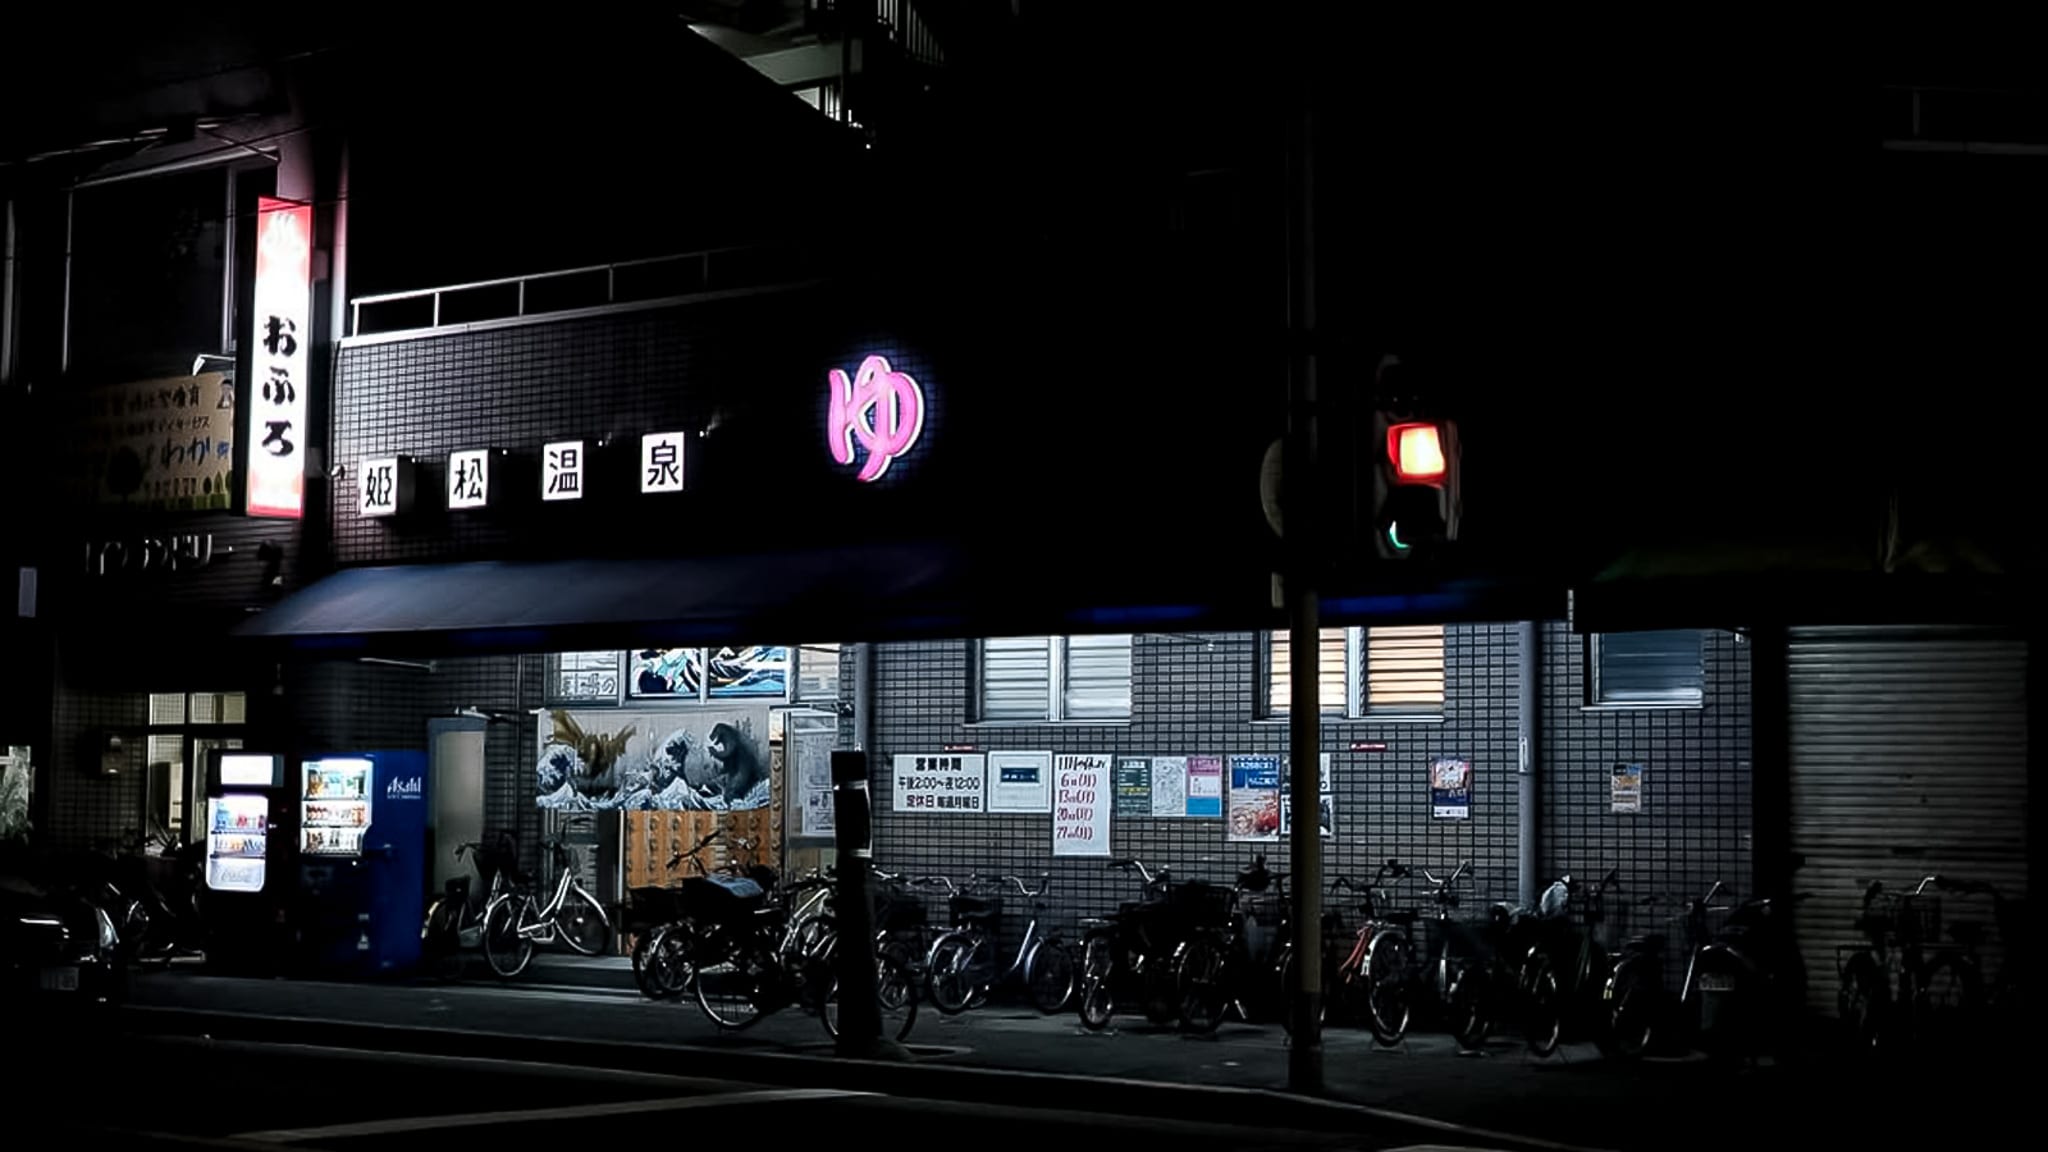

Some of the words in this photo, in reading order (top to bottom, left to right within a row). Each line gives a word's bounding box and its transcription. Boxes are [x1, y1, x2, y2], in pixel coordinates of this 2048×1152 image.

[262, 315, 297, 456] おふろ
[827, 354, 925, 484] ゆ
[365, 440, 681, 508] 姫松温泉
[387, 776, 422, 793] Asahi
[916, 757, 962, 772] 営業時間
[907, 795, 934, 808] 定休日
